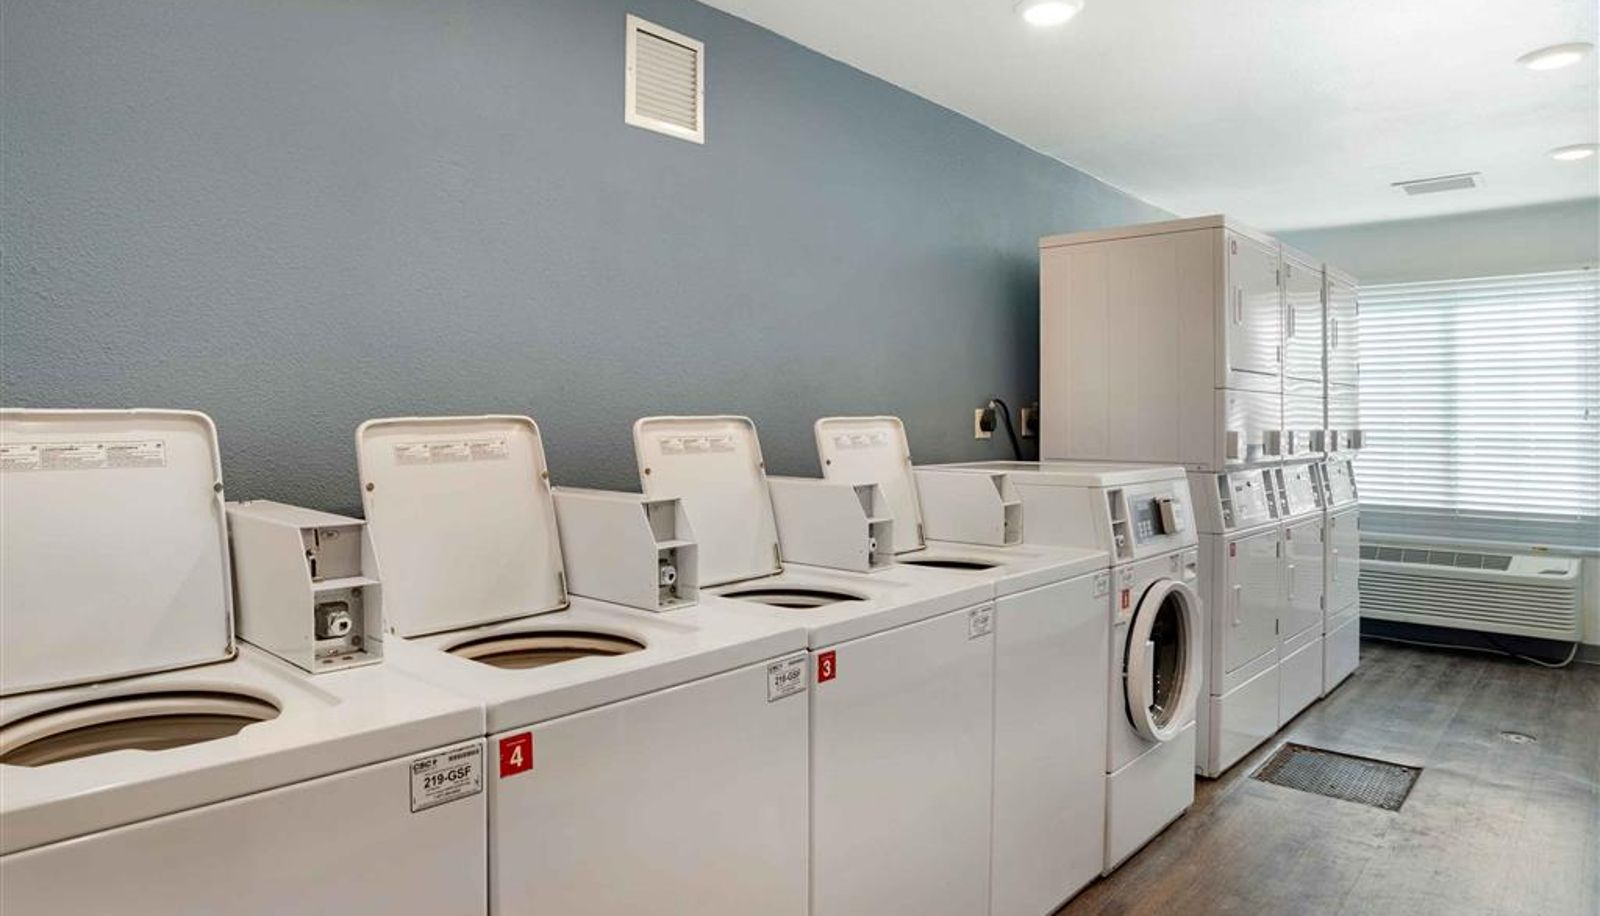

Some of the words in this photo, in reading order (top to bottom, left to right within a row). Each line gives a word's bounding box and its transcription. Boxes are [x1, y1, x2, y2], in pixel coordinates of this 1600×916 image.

[823, 660, 831, 677] 3
[510, 745, 523, 768] 4
[424, 766, 472, 788] 219-GSF
